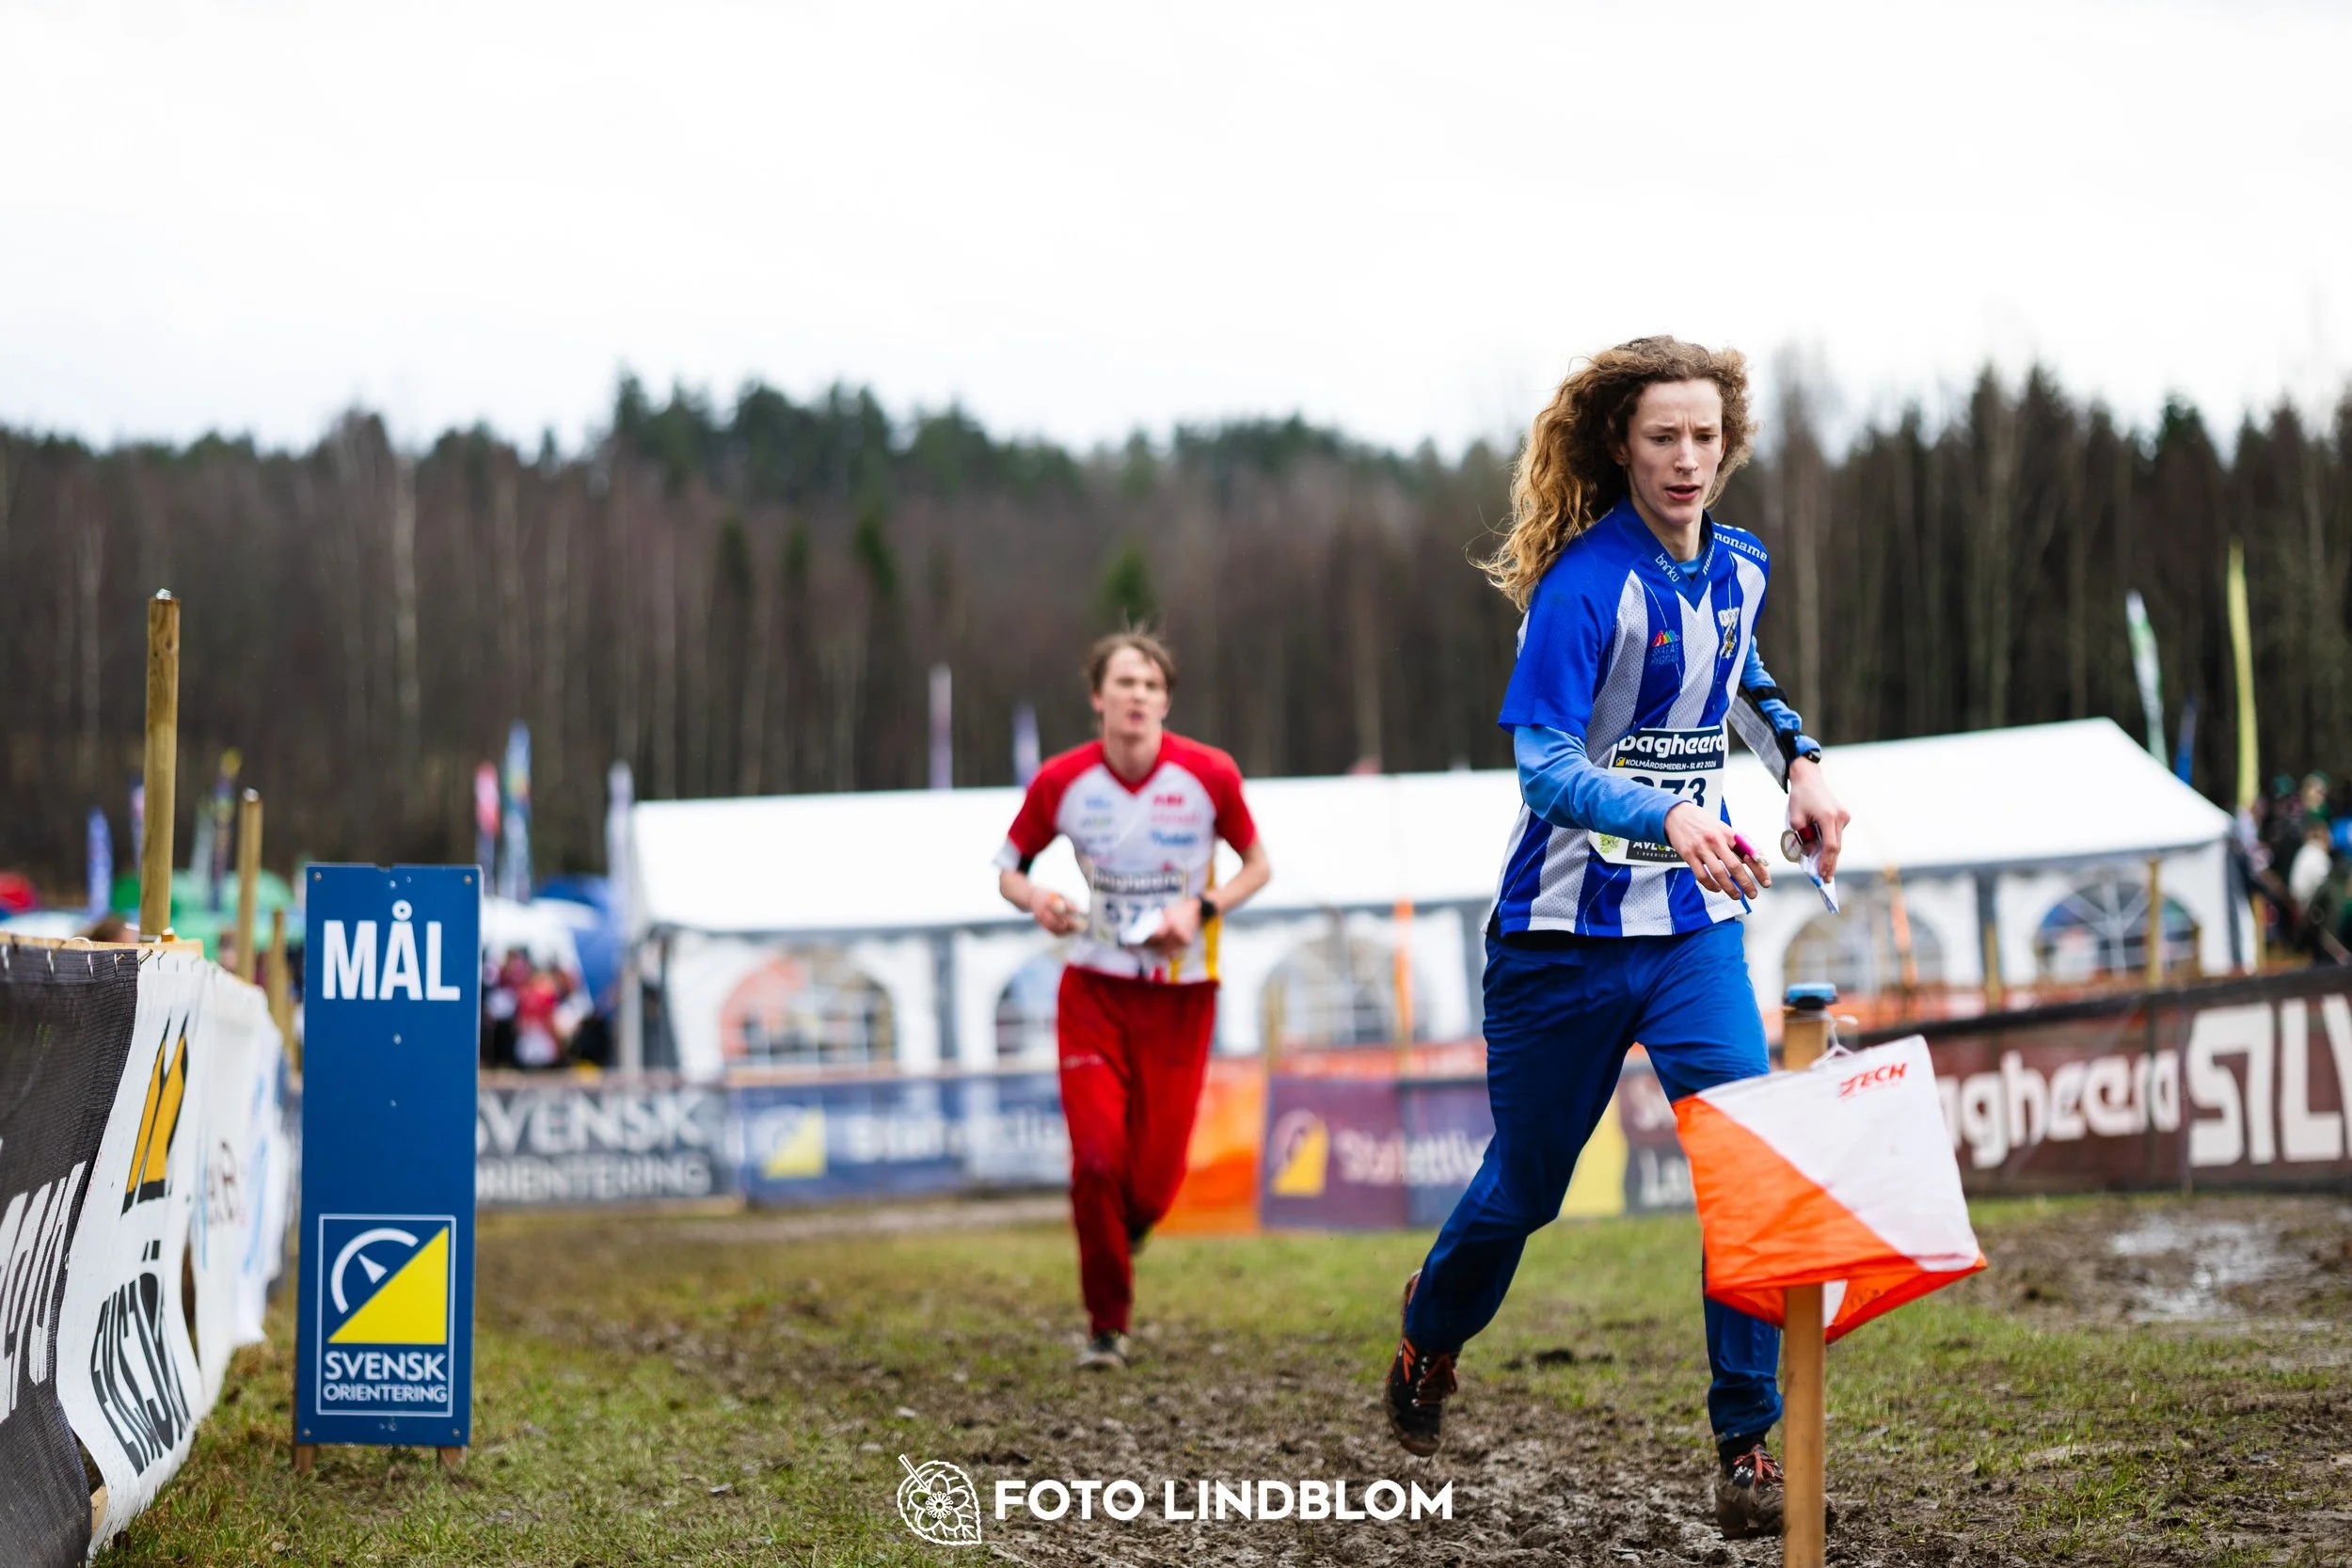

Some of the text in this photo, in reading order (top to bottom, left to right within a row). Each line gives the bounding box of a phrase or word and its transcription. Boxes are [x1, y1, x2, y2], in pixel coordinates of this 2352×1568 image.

[1713, 531, 1768, 562] noname
[1655, 553, 1680, 582] barku
[1625, 756, 1687, 770] KOLMÅRDSMEDELN
[1704, 759, 1717, 768] 2026
[323, 899, 461, 1002] MÅL
[477, 1149, 713, 1205] RIENTERING
[324, 1351, 447, 1382] SVENSK
[323, 1383, 448, 1403] ORIENTERING
